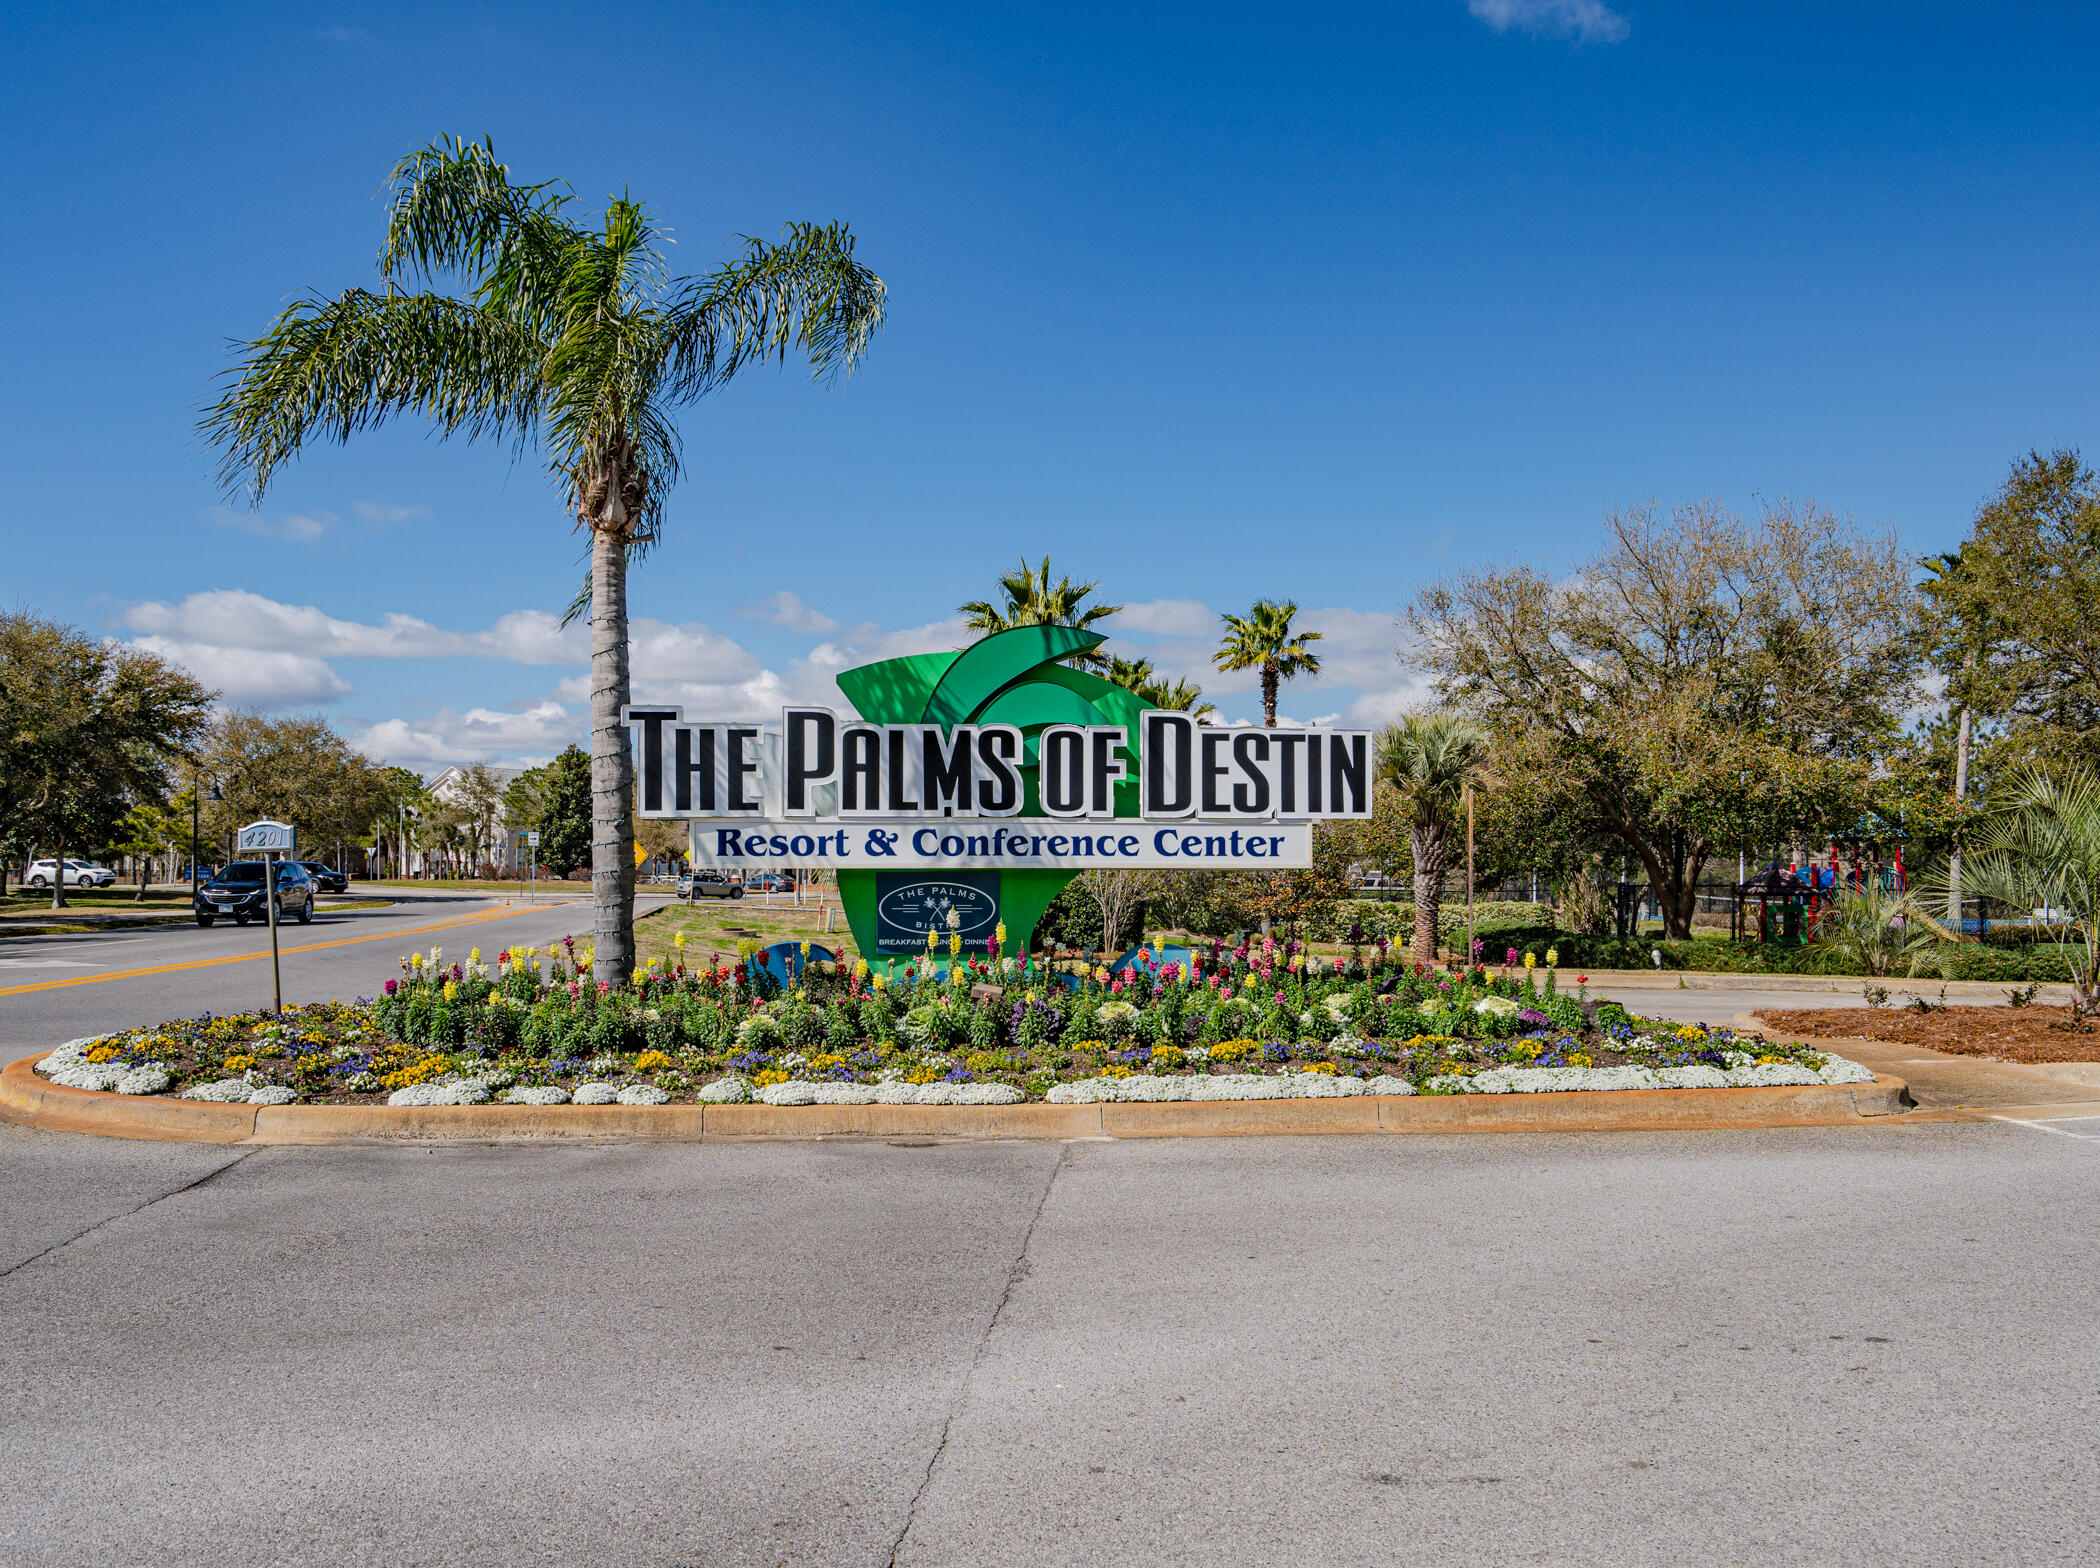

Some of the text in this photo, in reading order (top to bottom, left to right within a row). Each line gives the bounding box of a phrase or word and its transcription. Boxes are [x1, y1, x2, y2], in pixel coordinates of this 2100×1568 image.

[629, 711, 1366, 814] THE PALMS OF DESTIN
[244, 830, 283, 847] 4201
[716, 828, 1285, 857] Resort & Conference Center
[898, 887, 976, 901] THE PALMS
[878, 938, 927, 946] BREAKFAST
[964, 938, 990, 946] DINNE
